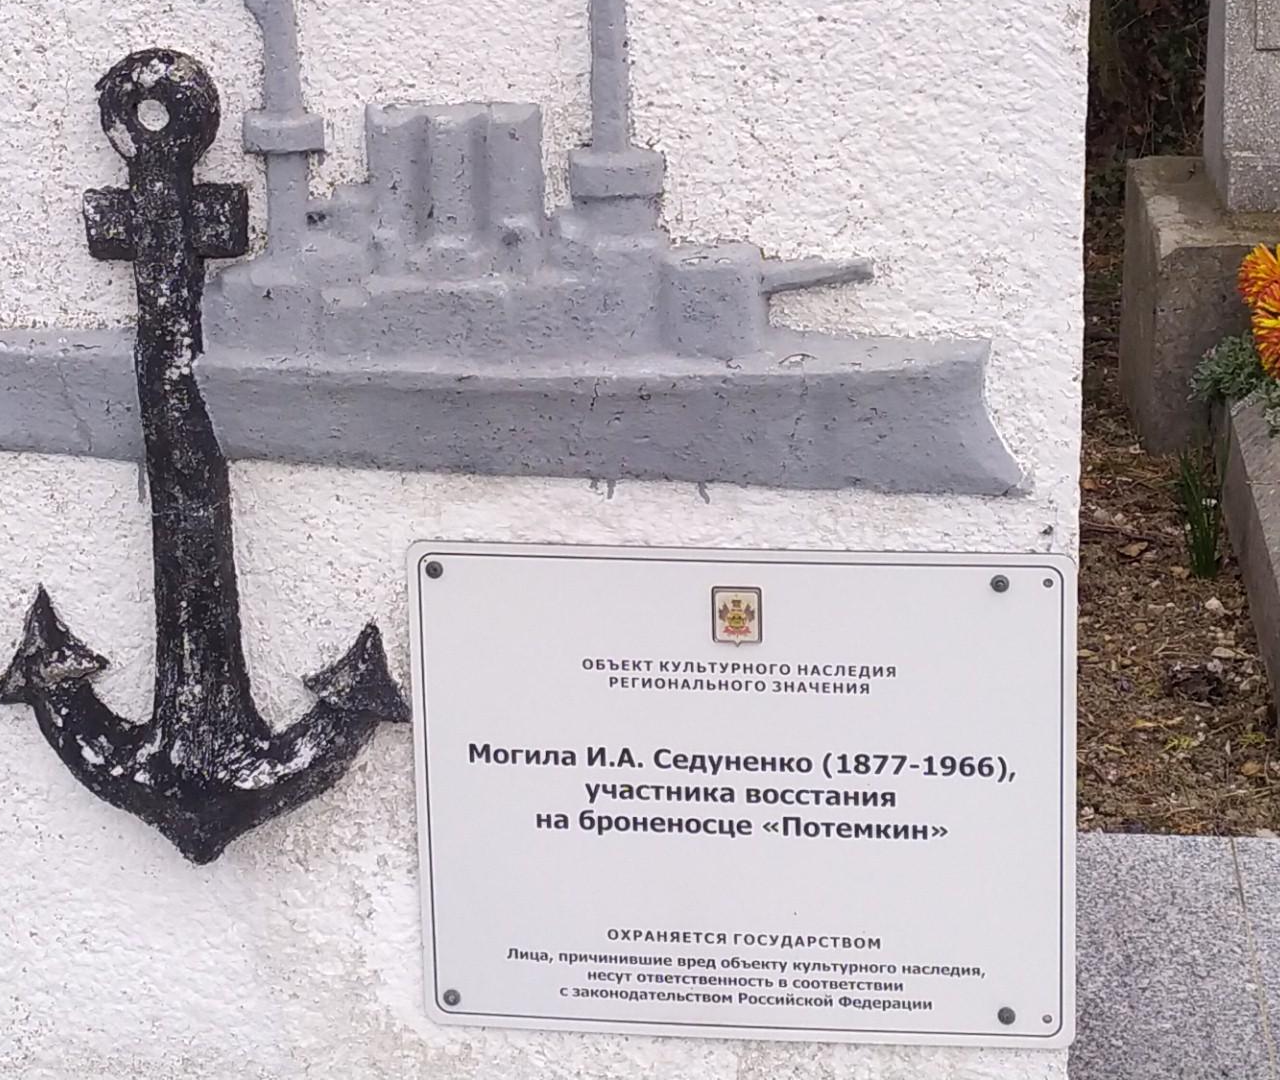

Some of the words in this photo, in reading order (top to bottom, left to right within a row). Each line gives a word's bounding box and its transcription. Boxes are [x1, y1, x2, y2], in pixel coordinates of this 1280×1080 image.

[582, 658, 653, 672] ОБЪЕКТ
[659, 660, 790, 676] КУЛЬТУРНОГО
[797, 664, 897, 680] НАСЛЕДИЯ
[609, 676, 766, 693] РЕГИОНАЛЬНОГО
[772, 681, 870, 695] ЗНАЧЕНИЯ
[468, 743, 577, 767] Могила
[587, 747, 644, 769] И.А.
[653, 749, 813, 776] Седуненко
[822, 752, 1016, 782] (1877-1966),
[585, 783, 735, 805] участника
[746, 787, 896, 808] восстания
[536, 814, 569, 830] на
[578, 809, 753, 838] броненосце
[762, 816, 949, 841] «Потемкин»
[607, 928, 727, 945] ОХРАНЯЕТСЯ
[733, 933, 881, 950] ГОСУДАРСТВОМ
[507, 947, 554, 963] Лица,
[558, 952, 673, 970] причинившие
[677, 956, 717, 970] вред
[720, 957, 788, 975] объекту
[792, 960, 897, 978] культурного
[901, 964, 986, 980] наследия,
[587, 972, 632, 986] несут
[636, 974, 774, 989] ответственность
[778, 978, 788, 988] в
[792, 978, 904, 993] соответствии
[559, 987, 569, 997] с
[572, 987, 733, 1005] законодательством
[738, 991, 834, 1008] Российской
[838, 995, 933, 1012] Федерации
